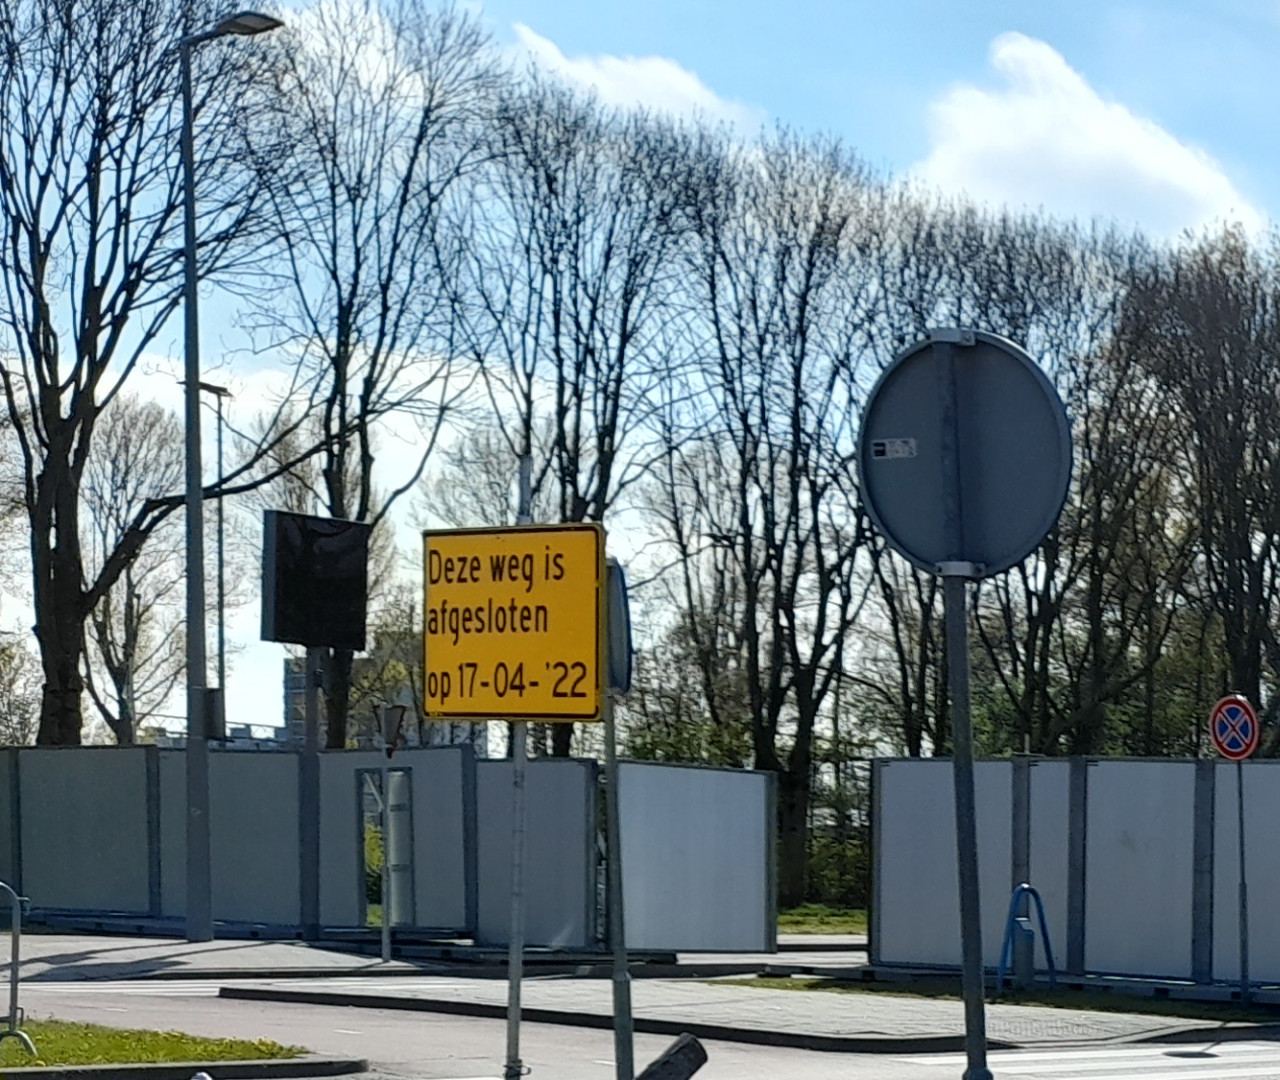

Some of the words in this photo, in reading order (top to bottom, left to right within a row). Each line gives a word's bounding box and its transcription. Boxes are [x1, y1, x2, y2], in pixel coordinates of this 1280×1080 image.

[429, 549, 481, 585] Deze
[490, 552, 534, 593] weg
[544, 545, 565, 581] is
[428, 597, 548, 646] afgesloten
[428, 671, 451, 705] op
